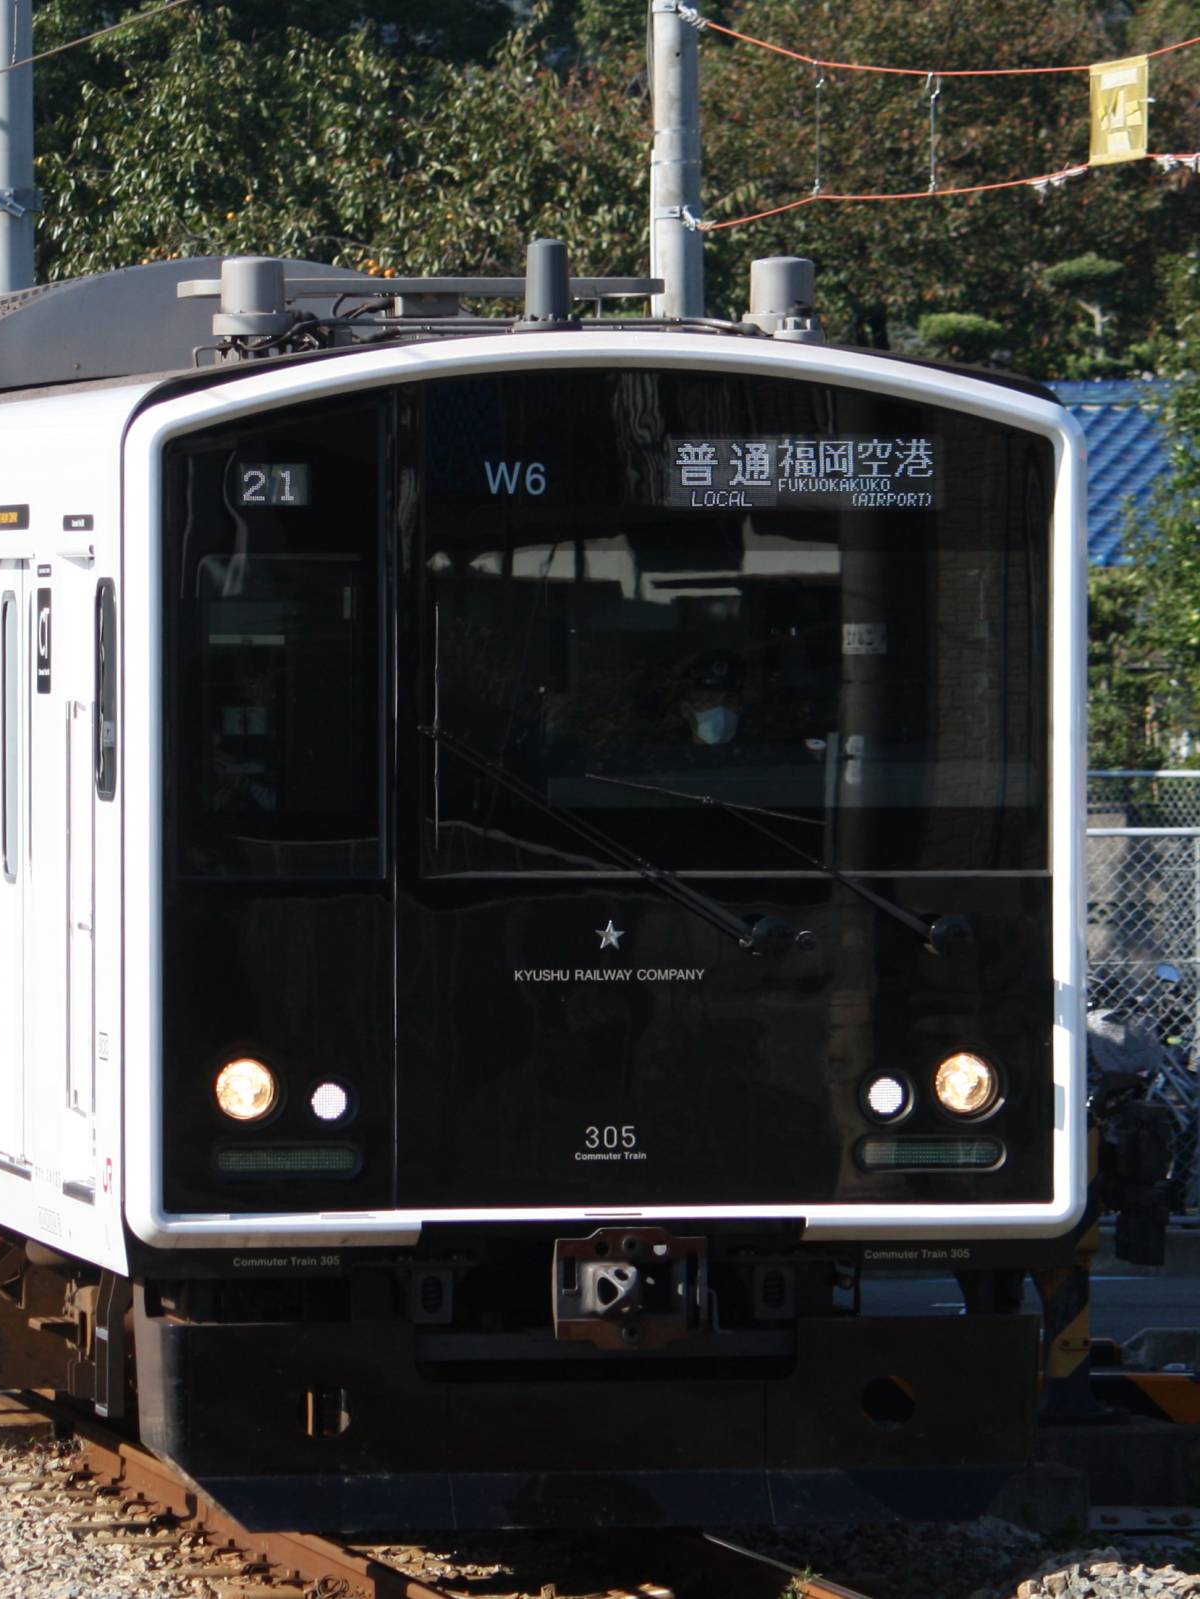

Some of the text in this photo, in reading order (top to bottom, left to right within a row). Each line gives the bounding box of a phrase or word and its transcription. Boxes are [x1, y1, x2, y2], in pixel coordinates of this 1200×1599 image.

[676, 438, 934, 487] 普通 福岡空港
[243, 470, 294, 502] 21
[484, 460, 547, 496] W6
[778, 478, 891, 493] FUKUOKAKUKO
[691, 491, 753, 507] LOCAL
[852, 492, 933, 508] (AIRPORT)
[514, 968, 705, 982] KYUSHU RAILWAY COMPANY
[585, 1125, 637, 1149] 305
[574, 1151, 647, 1161] Commuter Train
[232, 1255, 341, 1268] Commuter Train 305
[863, 1247, 971, 1260] Commuter Train 305
